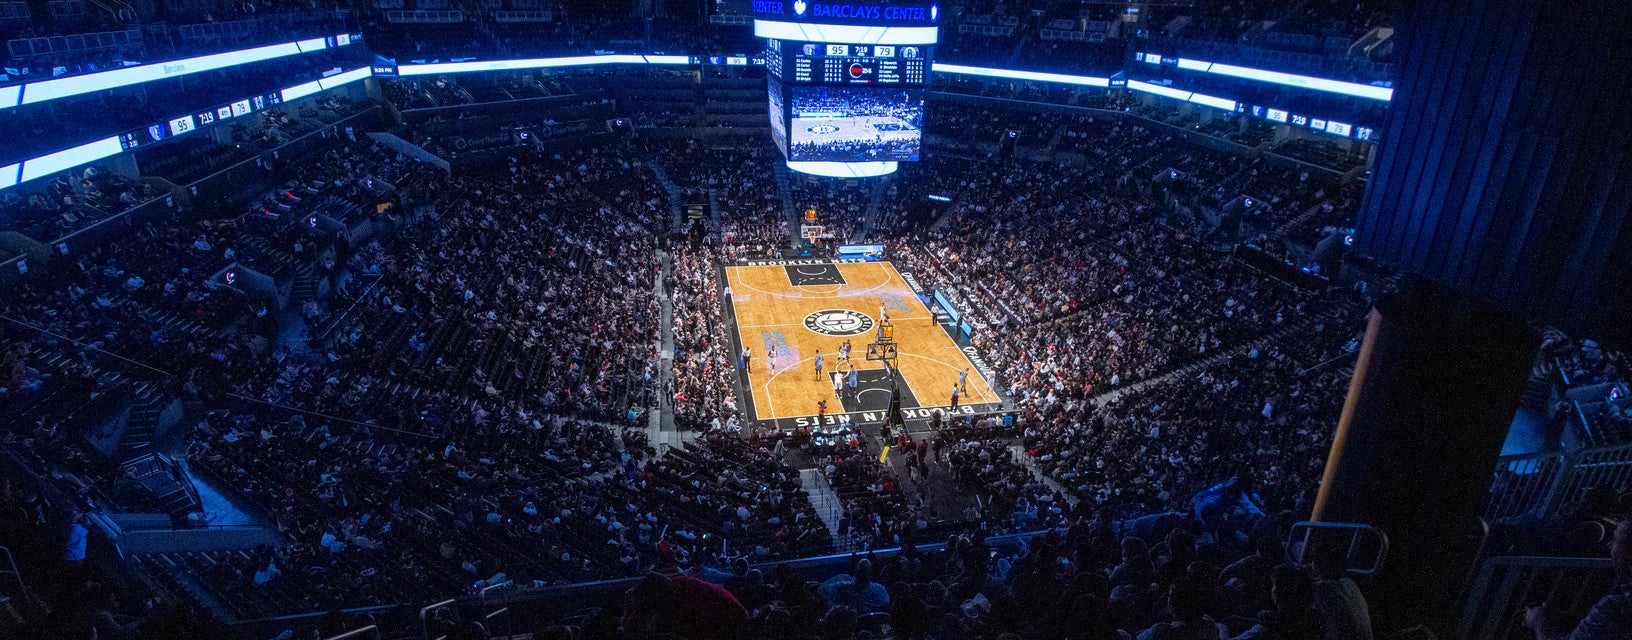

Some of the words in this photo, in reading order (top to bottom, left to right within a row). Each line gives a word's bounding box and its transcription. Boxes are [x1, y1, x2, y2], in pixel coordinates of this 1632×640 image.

[813, 4, 880, 19] BARCLAYS
[884, 6, 925, 20] CENTER
[832, 46, 844, 55] 95
[879, 47, 891, 56] 79
[178, 119, 188, 131] 95
[199, 112, 214, 125] 7:19
[237, 103, 246, 113] 79
[1273, 111, 1281, 119] 95
[1292, 115, 1306, 125] 7:19
[1334, 123, 1343, 133] 79
[796, 413, 850, 428] NETS
